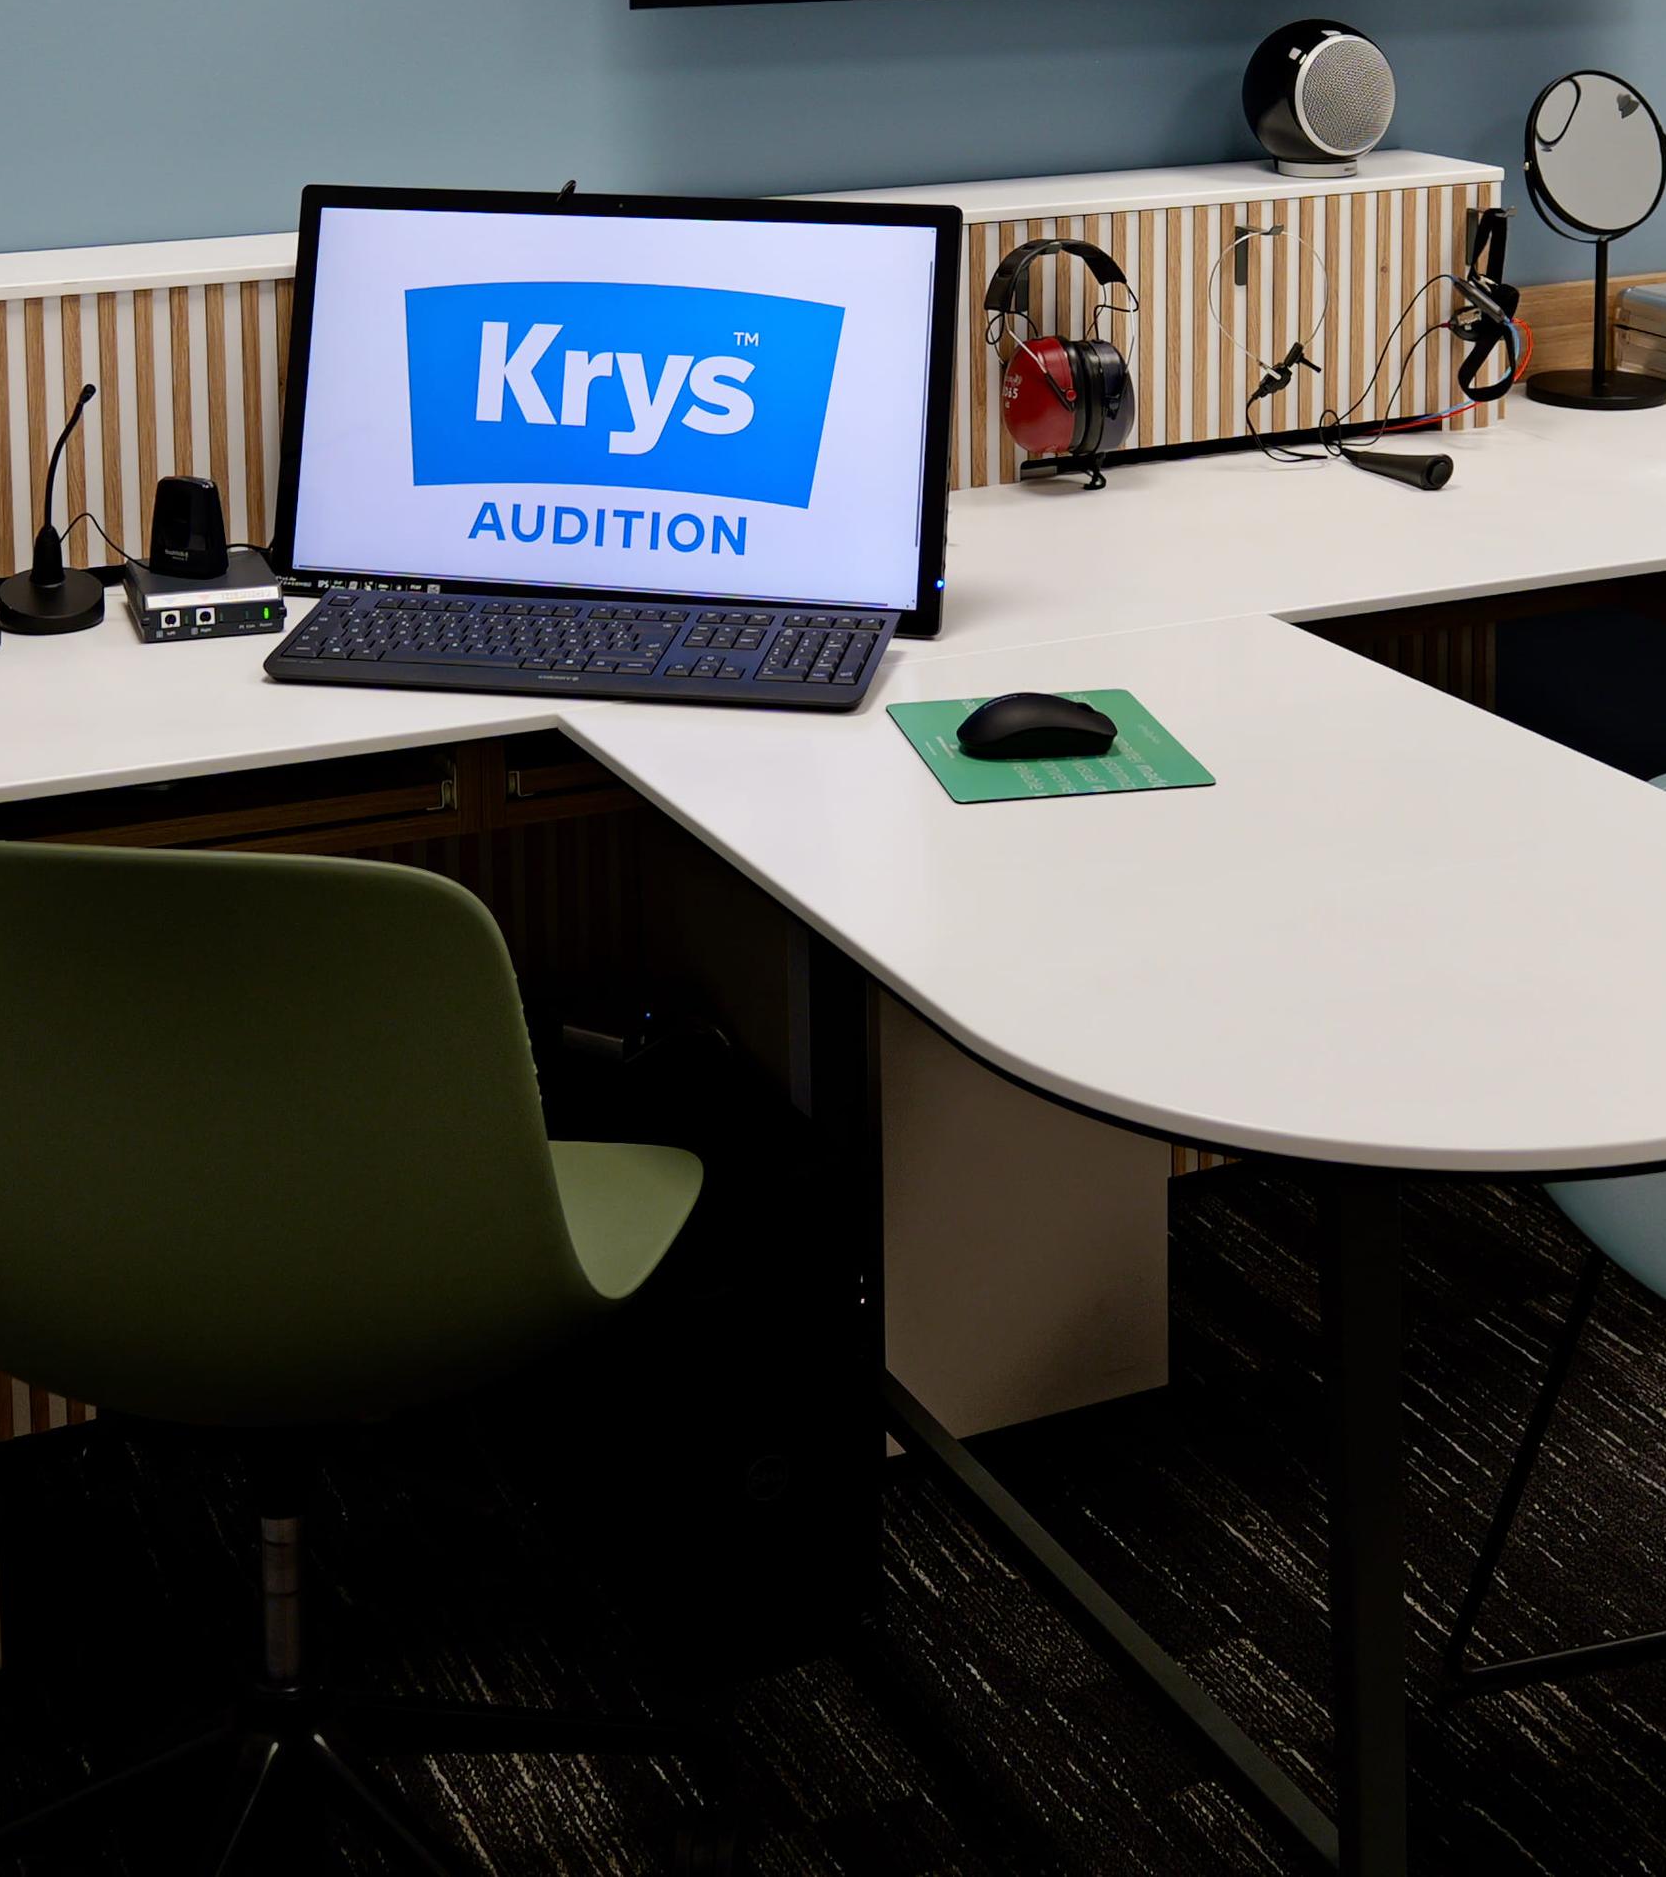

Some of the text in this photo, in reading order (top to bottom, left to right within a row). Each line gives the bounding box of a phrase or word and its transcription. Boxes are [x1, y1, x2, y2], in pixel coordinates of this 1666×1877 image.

[733, 331, 759, 347] TM
[475, 321, 756, 455] Krys
[467, 501, 748, 556] AUDITION
